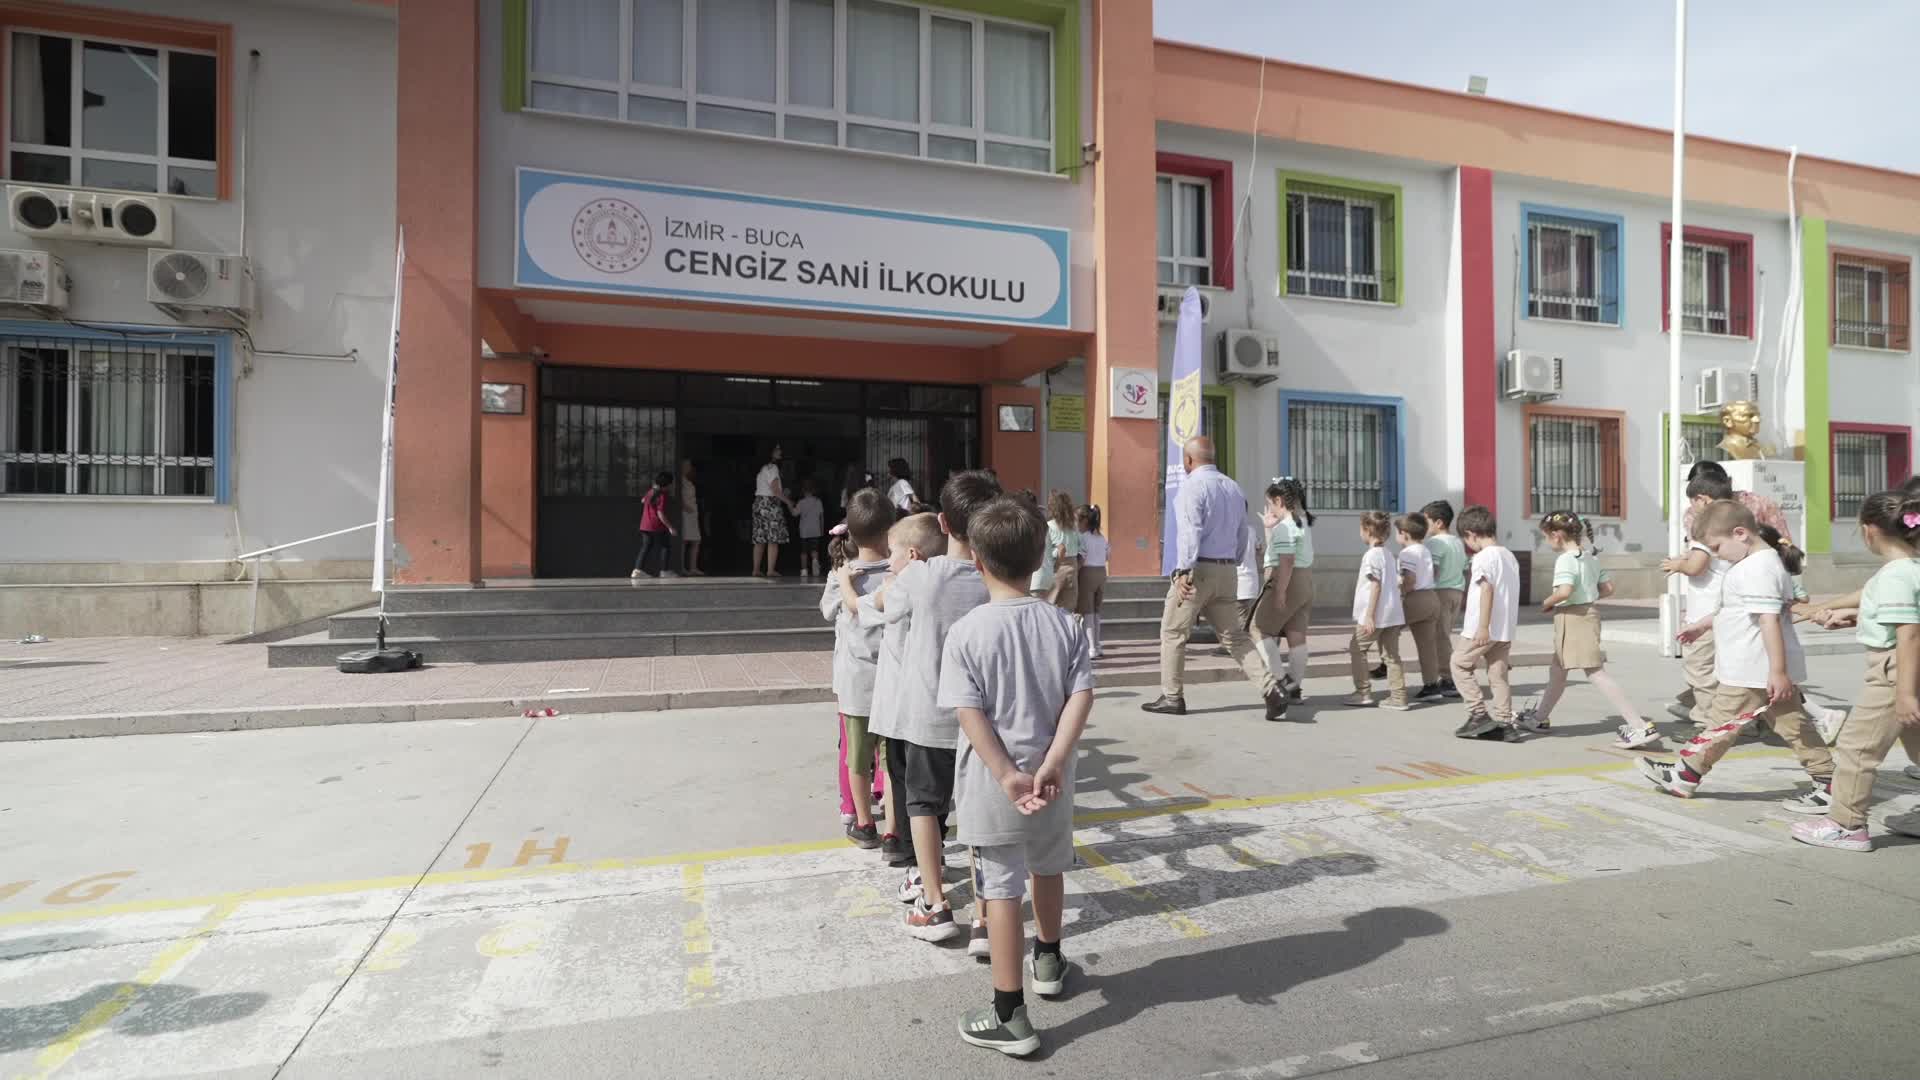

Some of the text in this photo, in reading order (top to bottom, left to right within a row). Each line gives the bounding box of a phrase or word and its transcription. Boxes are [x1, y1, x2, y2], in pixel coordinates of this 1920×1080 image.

[665, 216, 725, 242] İZMİR
[745, 227, 804, 249] BUCA
[664, 248, 1025, 303] CENGİZ SANİ İLKOKULU
